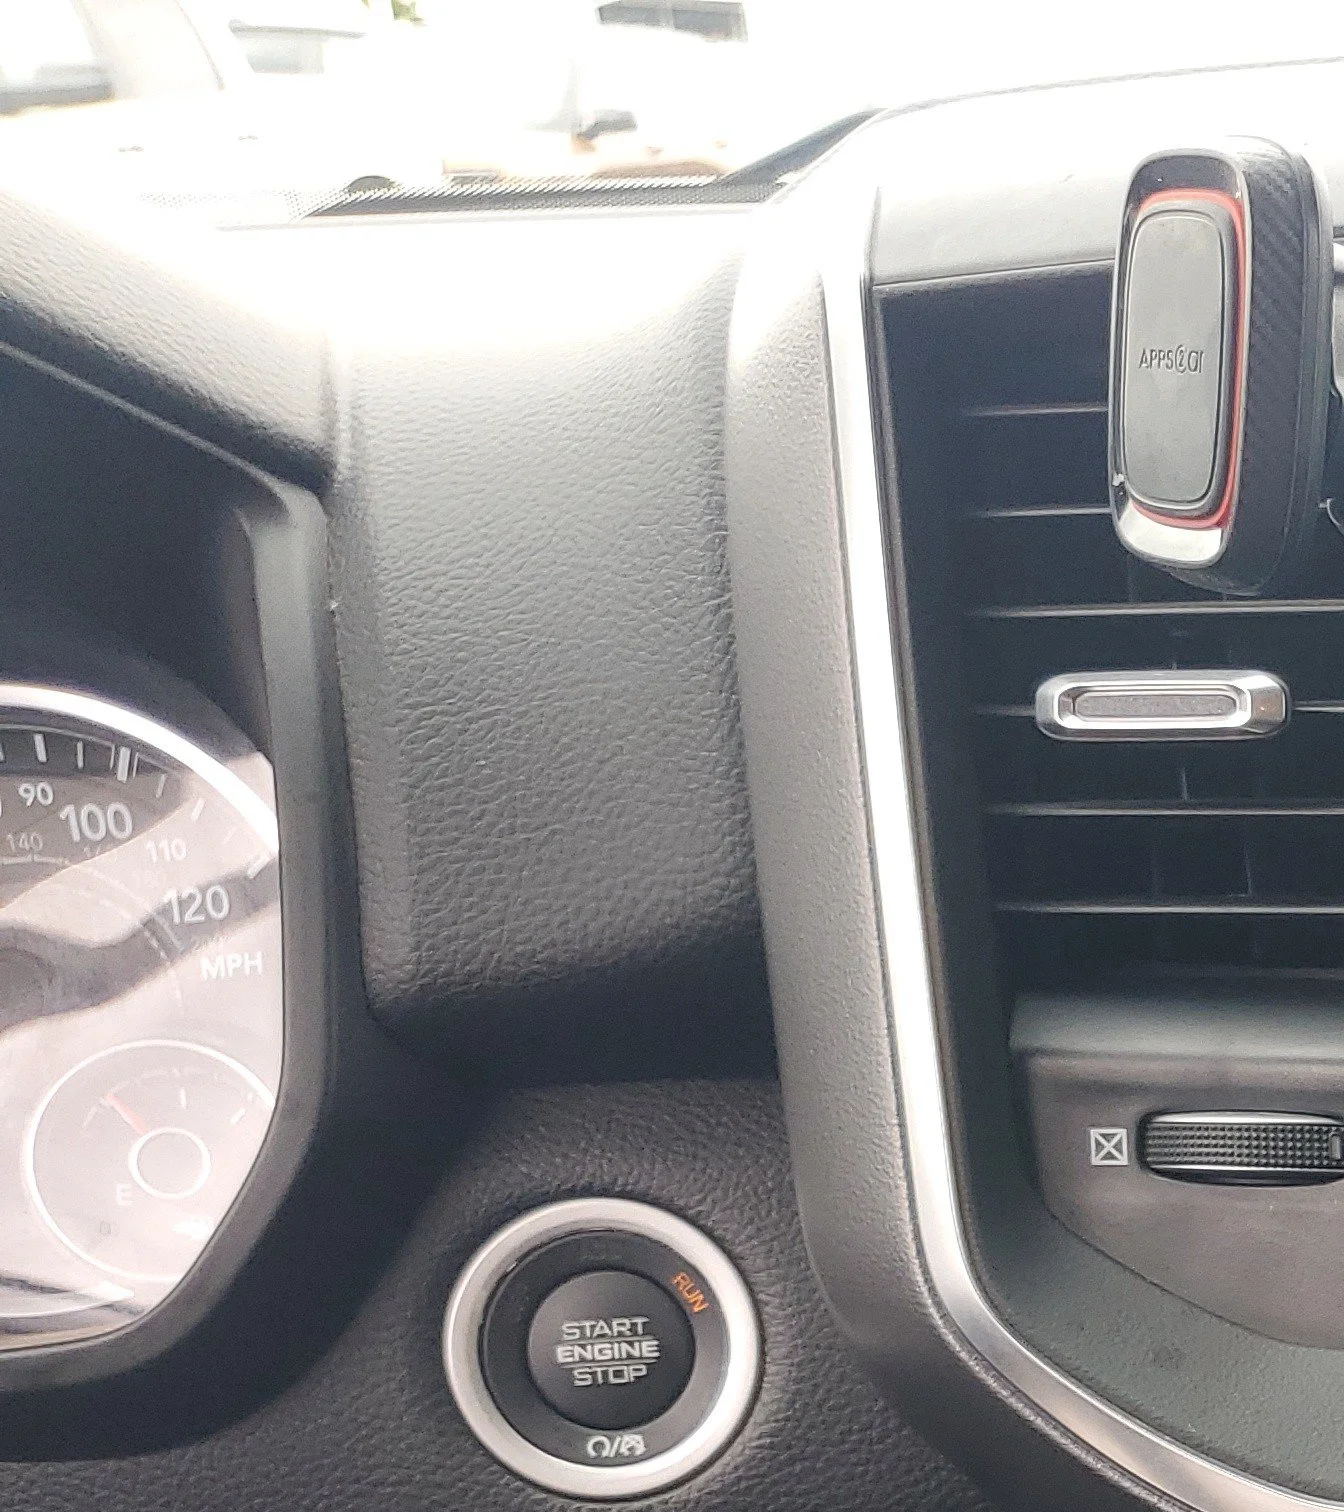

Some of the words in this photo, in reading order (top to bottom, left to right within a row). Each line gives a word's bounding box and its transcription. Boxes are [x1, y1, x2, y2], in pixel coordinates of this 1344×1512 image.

[17, 780, 54, 807] 90
[58, 801, 134, 843] 100
[145, 836, 188, 863] 110
[162, 884, 231, 925] 120
[200, 950, 264, 981] MPH
[671, 1271, 710, 1315] RUN
[561, 1316, 651, 1341] START
[556, 1340, 660, 1364] ENGINE
[572, 1364, 649, 1387] STOP
